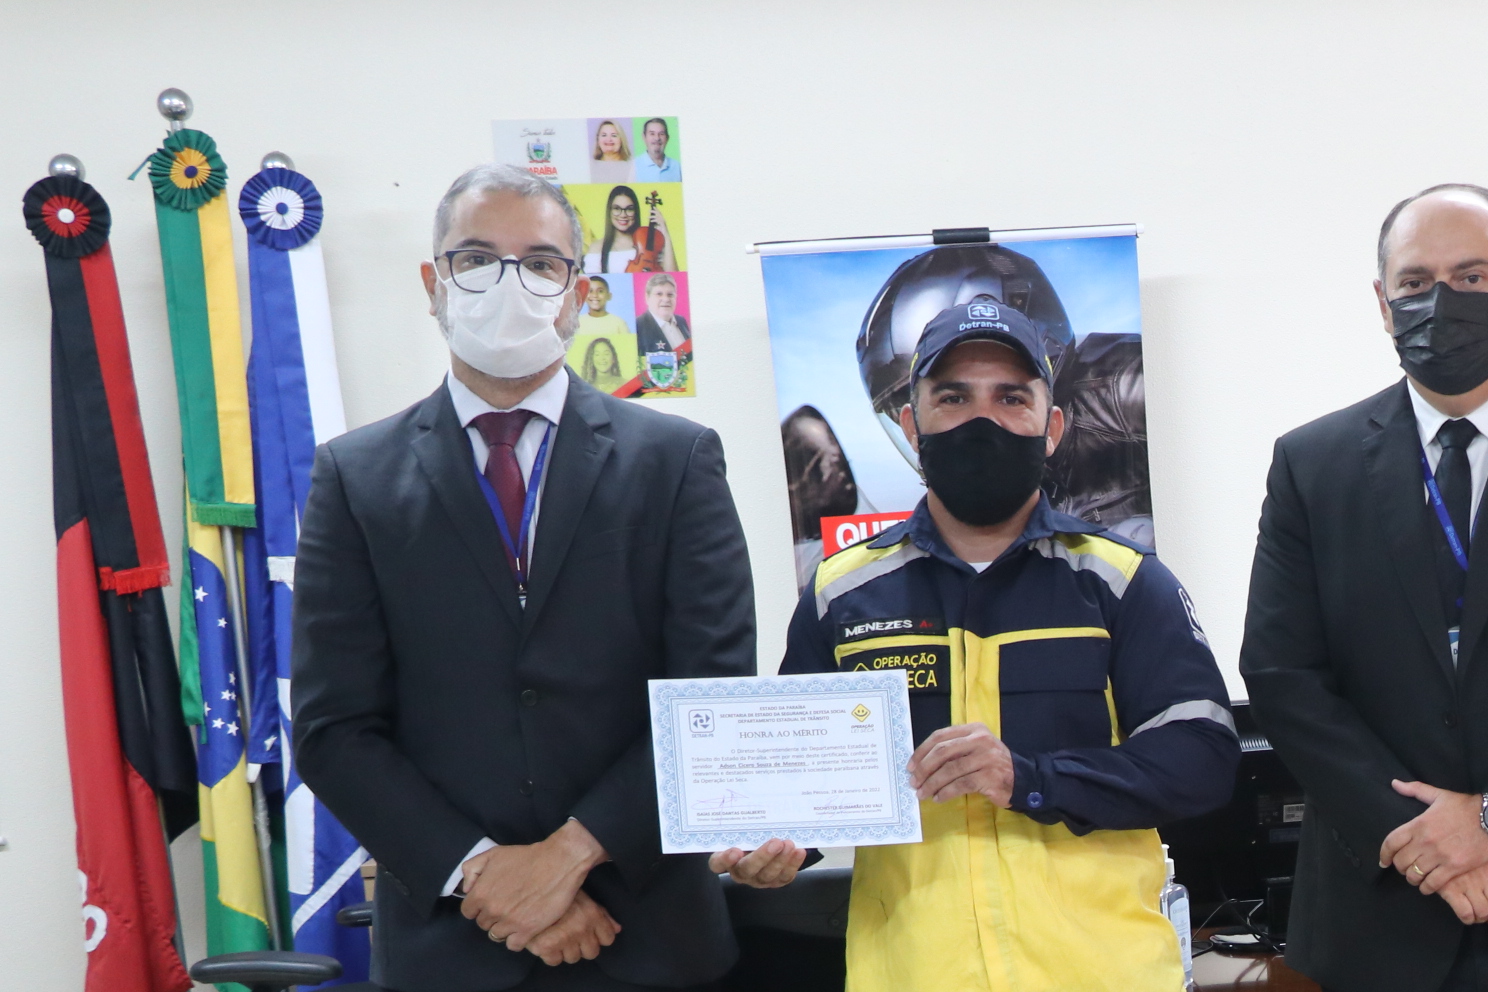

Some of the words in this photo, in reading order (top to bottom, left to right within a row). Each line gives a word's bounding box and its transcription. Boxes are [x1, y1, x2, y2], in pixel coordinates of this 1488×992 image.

[959, 320, 1010, 332] Detran-PB
[836, 520, 907, 549] QU
[845, 620, 912, 638] MENEZES
[873, 652, 937, 669] OPERAÇÃO
[907, 670, 938, 689] ECA
[777, 730, 790, 738] AO
[793, 729, 828, 737] MÉRITO
